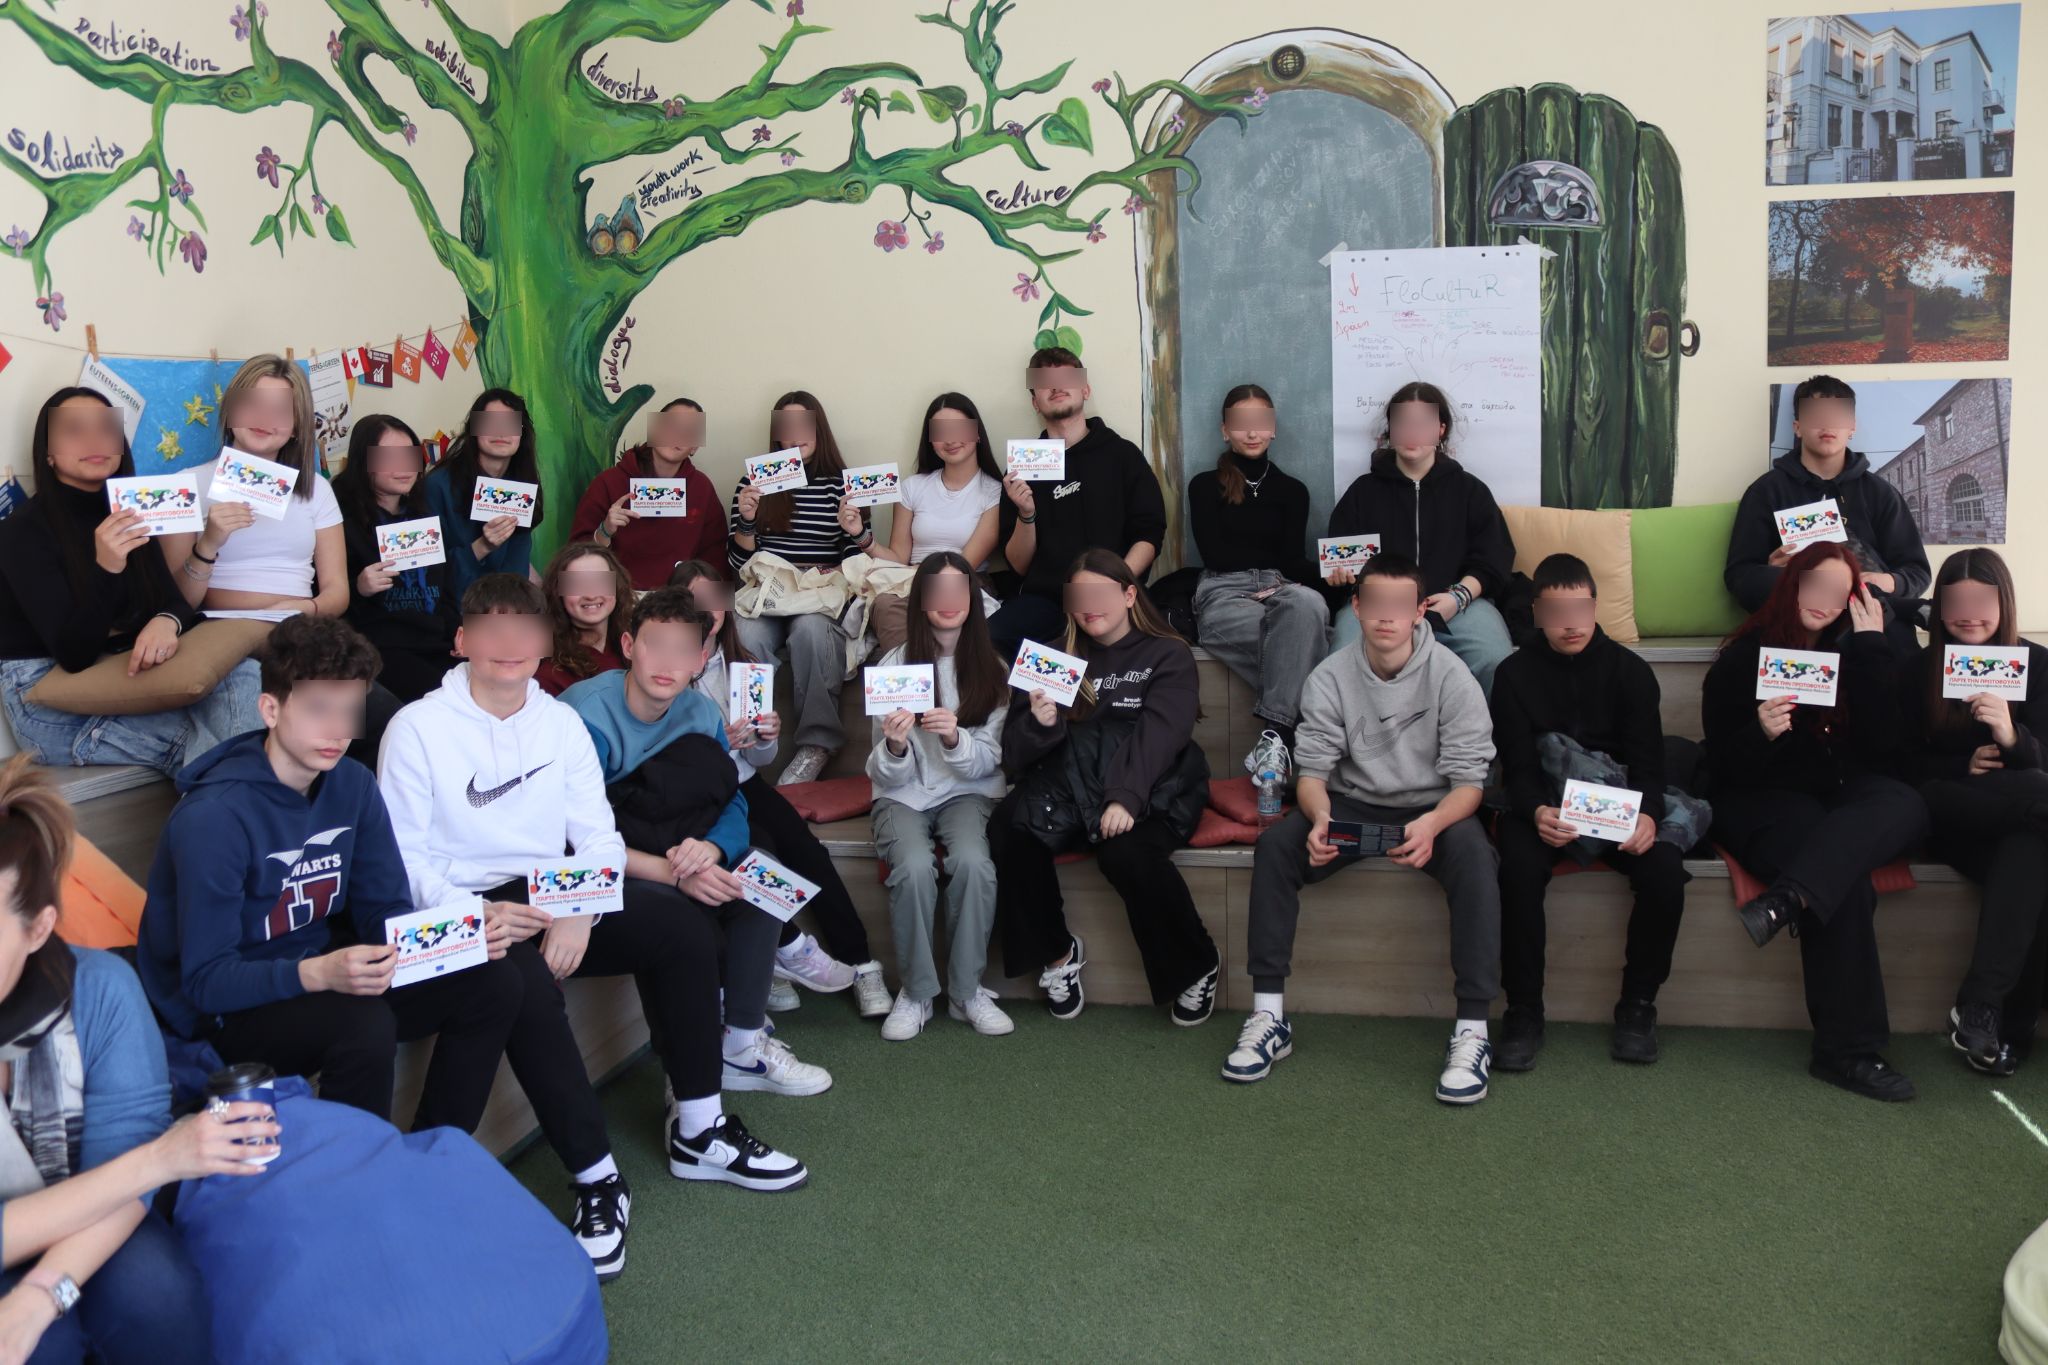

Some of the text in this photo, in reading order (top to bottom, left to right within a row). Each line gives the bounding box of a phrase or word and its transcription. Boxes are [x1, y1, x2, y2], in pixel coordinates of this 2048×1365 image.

[75, 17, 220, 71] Participation
[425, 38, 476, 97] mobility
[586, 52, 658, 103] diversity
[8, 128, 124, 172] Solidarity
[639, 148, 703, 198] youth work
[640, 178, 703, 209] creativity
[603, 316, 636, 393] dialogue
